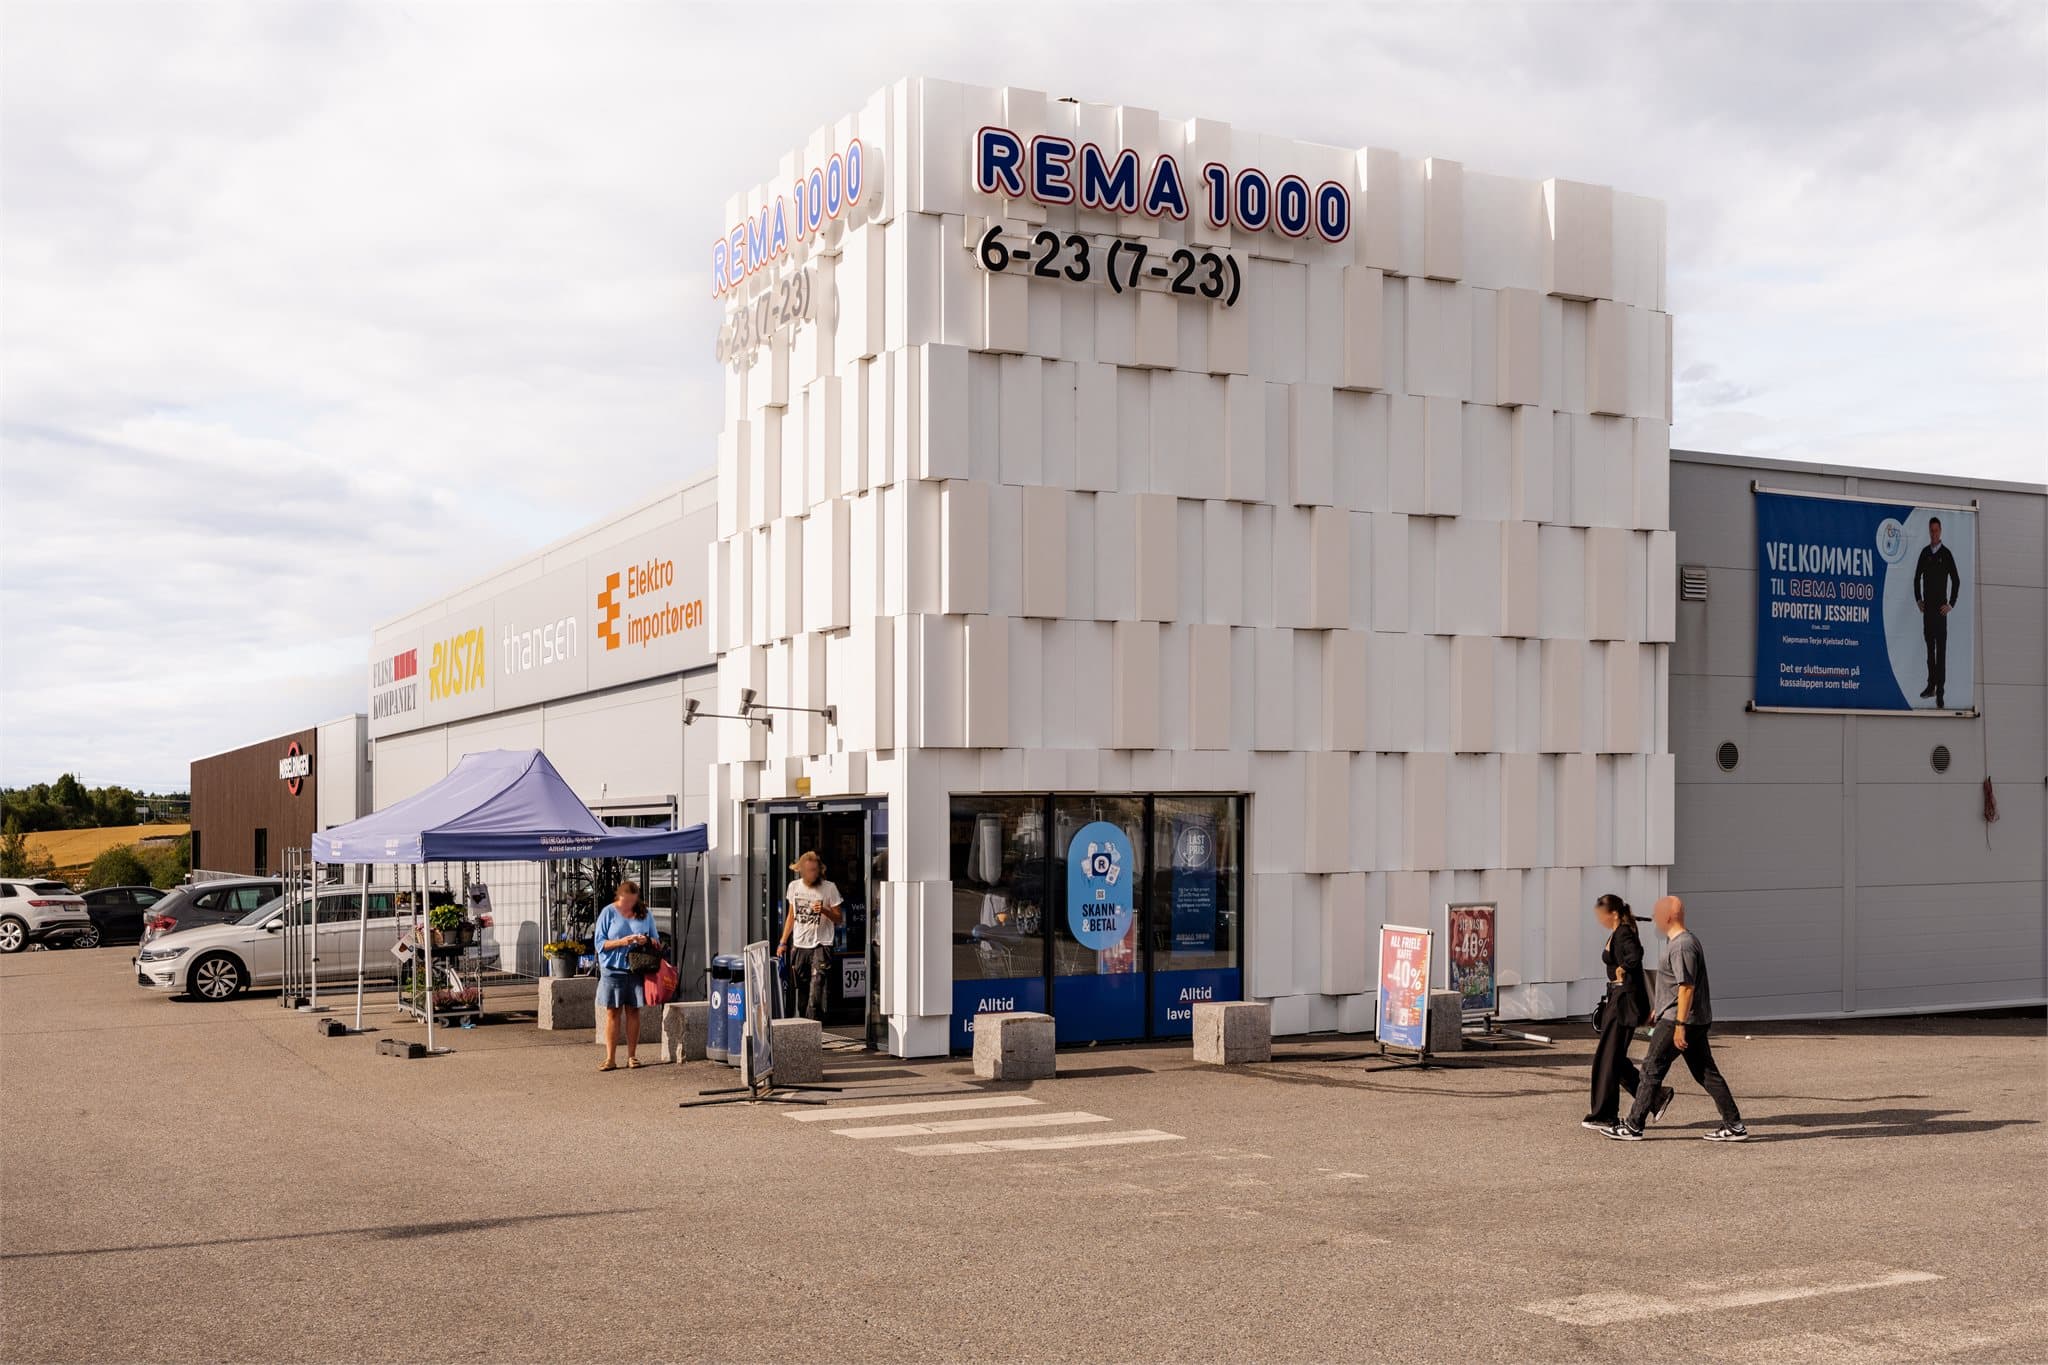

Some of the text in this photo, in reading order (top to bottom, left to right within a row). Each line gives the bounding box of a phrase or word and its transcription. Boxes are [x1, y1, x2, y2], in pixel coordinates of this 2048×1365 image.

[974, 126, 1351, 244] REMA 1000
[712, 138, 863, 299] REMA 1000
[981, 225, 1242, 307] 6-23 (7-23)
[1766, 541, 1873, 577] VELKOMMEN
[628, 558, 674, 599] Elektro
[1771, 578, 1875, 601] TIL REMA 1000
[628, 599, 703, 648] importøren
[1772, 602, 1870, 623] BYPORTEN JESSHEIM
[503, 616, 577, 675] thansen
[373, 657, 393, 689] FLISE
[429, 626, 486, 703] RUSTA
[1780, 663, 1860, 677] Det er sluttsummen på
[1780, 677, 1860, 690] kassalappen som teller
[373, 683, 417, 720] KOMPANIET
[1082, 903, 1115, 918] SKANN
[1387, 960, 1422, 991] -40%
[977, 997, 1014, 1012] Alltid
[1179, 987, 1212, 1001] Alltid
[963, 1019, 974, 1033] la
[1167, 1007, 1191, 1021] lave
